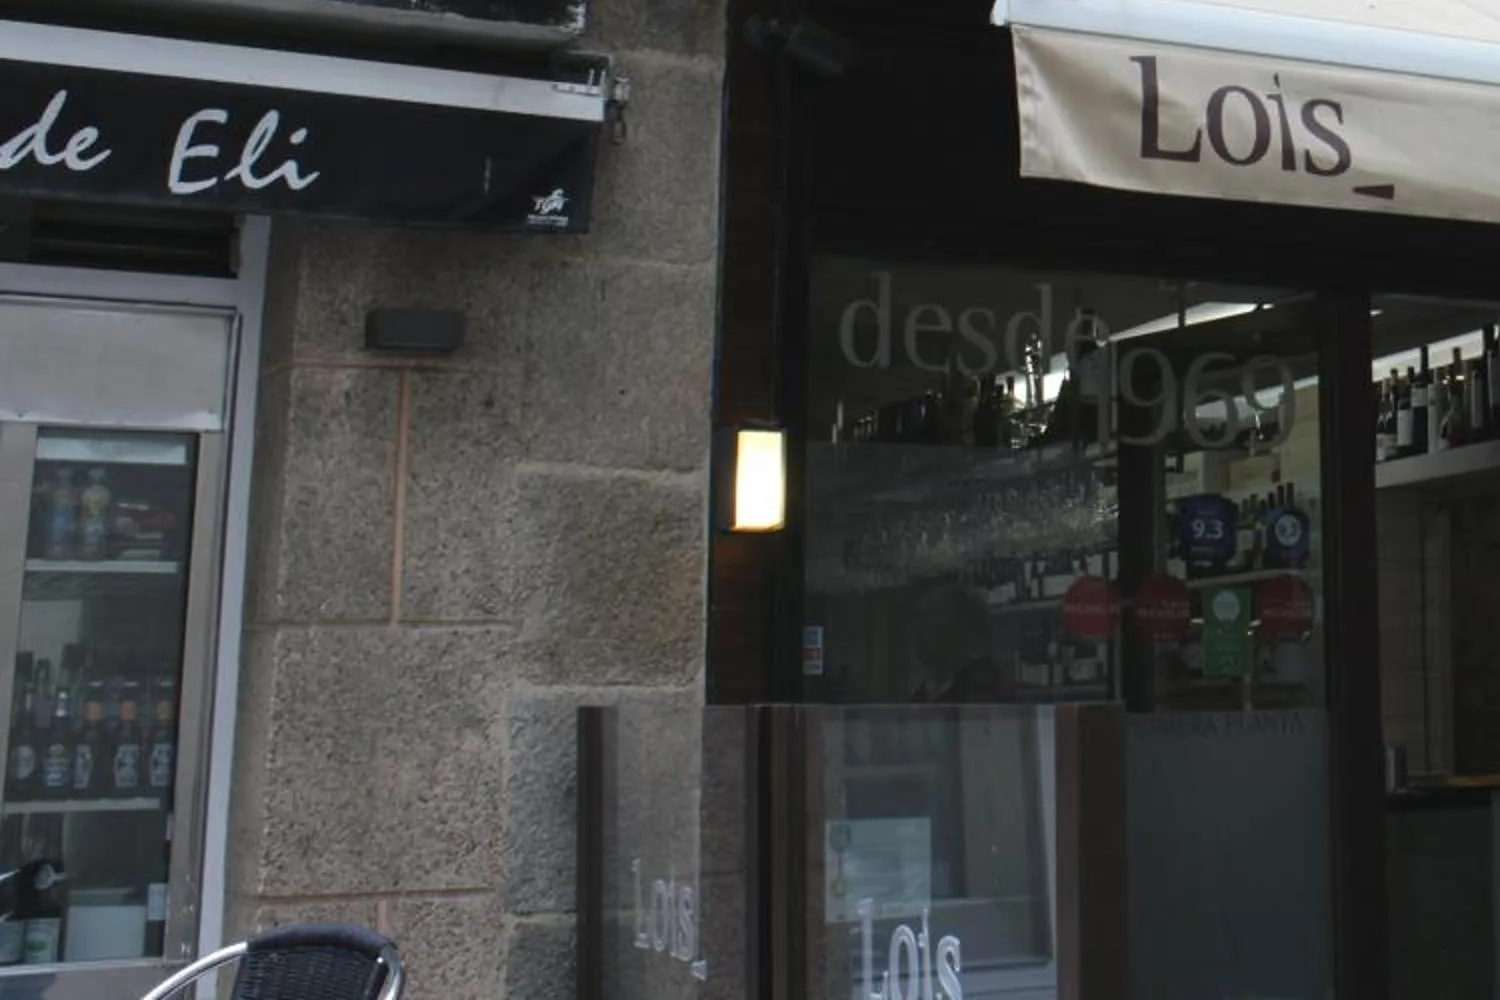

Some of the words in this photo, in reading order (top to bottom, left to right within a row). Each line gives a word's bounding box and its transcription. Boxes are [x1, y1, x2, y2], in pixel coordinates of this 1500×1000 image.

[0, 89, 111, 171] de
[168, 108, 321, 195] Eli
[1130, 56, 1353, 178] Lois
[838, 272, 1110, 378] desde
[1084, 345, 1298, 450] 1969
[630, 857, 696, 963] Lois
[856, 896, 963, 1000] Lois
